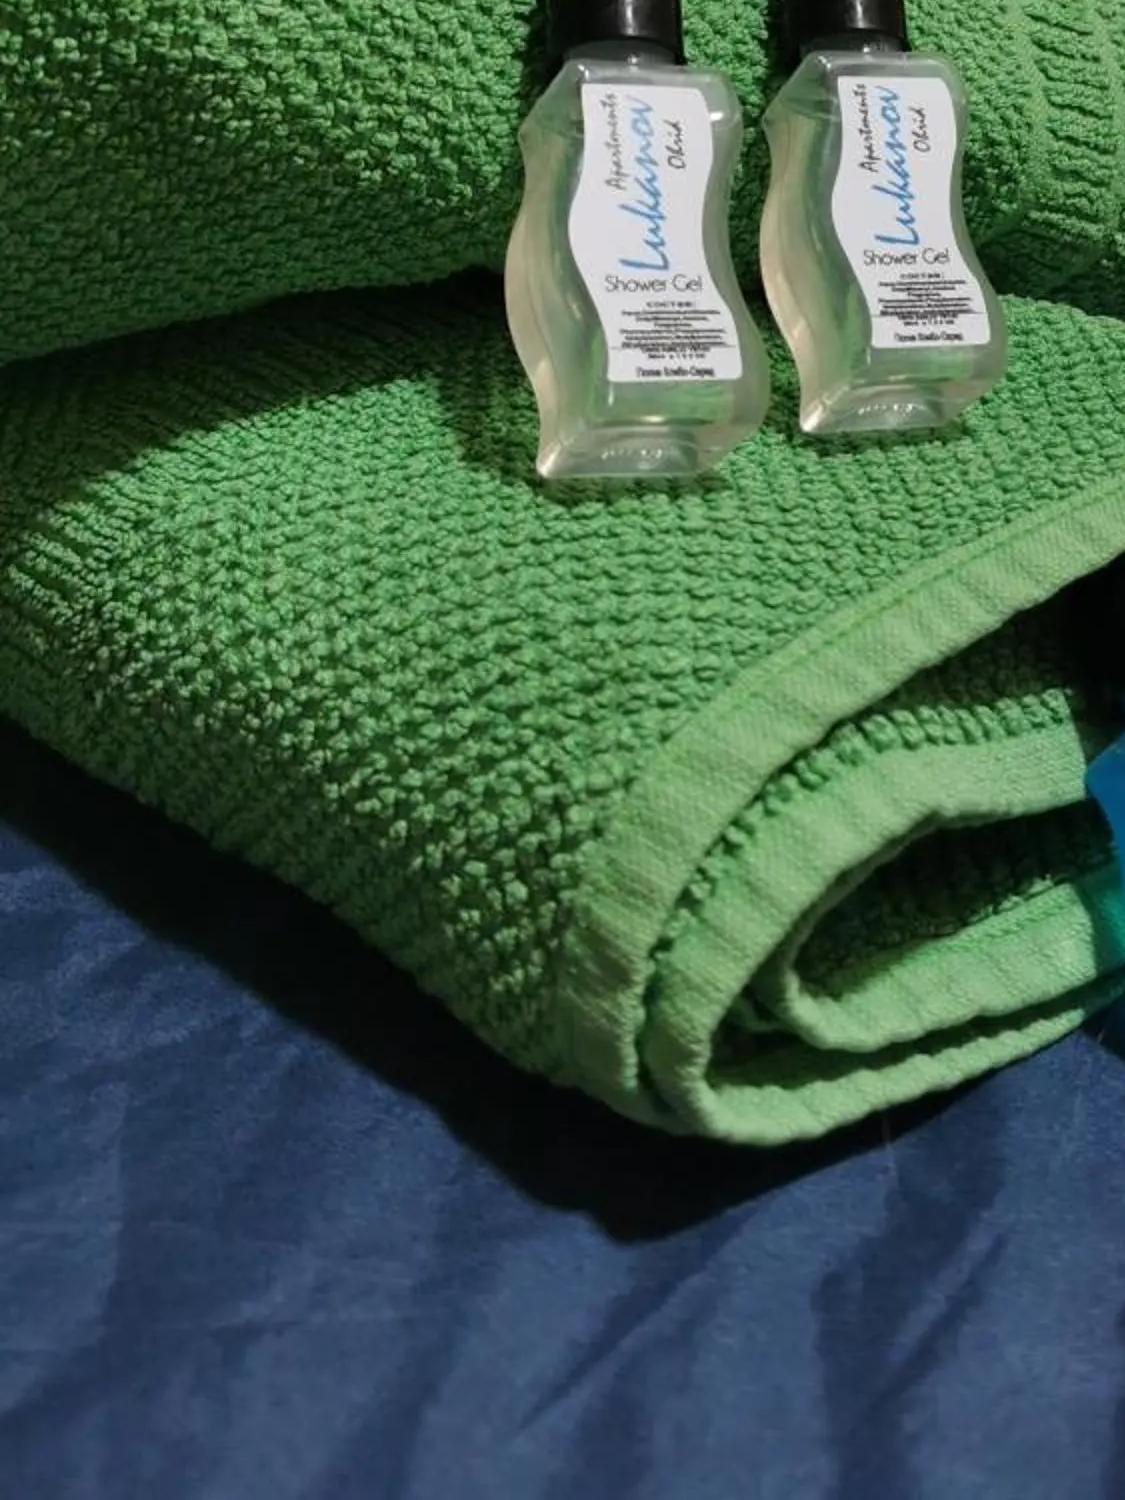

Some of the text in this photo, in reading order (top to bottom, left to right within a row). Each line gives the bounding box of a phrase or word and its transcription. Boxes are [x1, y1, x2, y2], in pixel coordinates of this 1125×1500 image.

[604, 92, 630, 191] Apartments
[852, 83, 878, 173] Apartments
[604, 273, 703, 293] Shower Gel
[863, 248, 950, 267] Shower Gel
